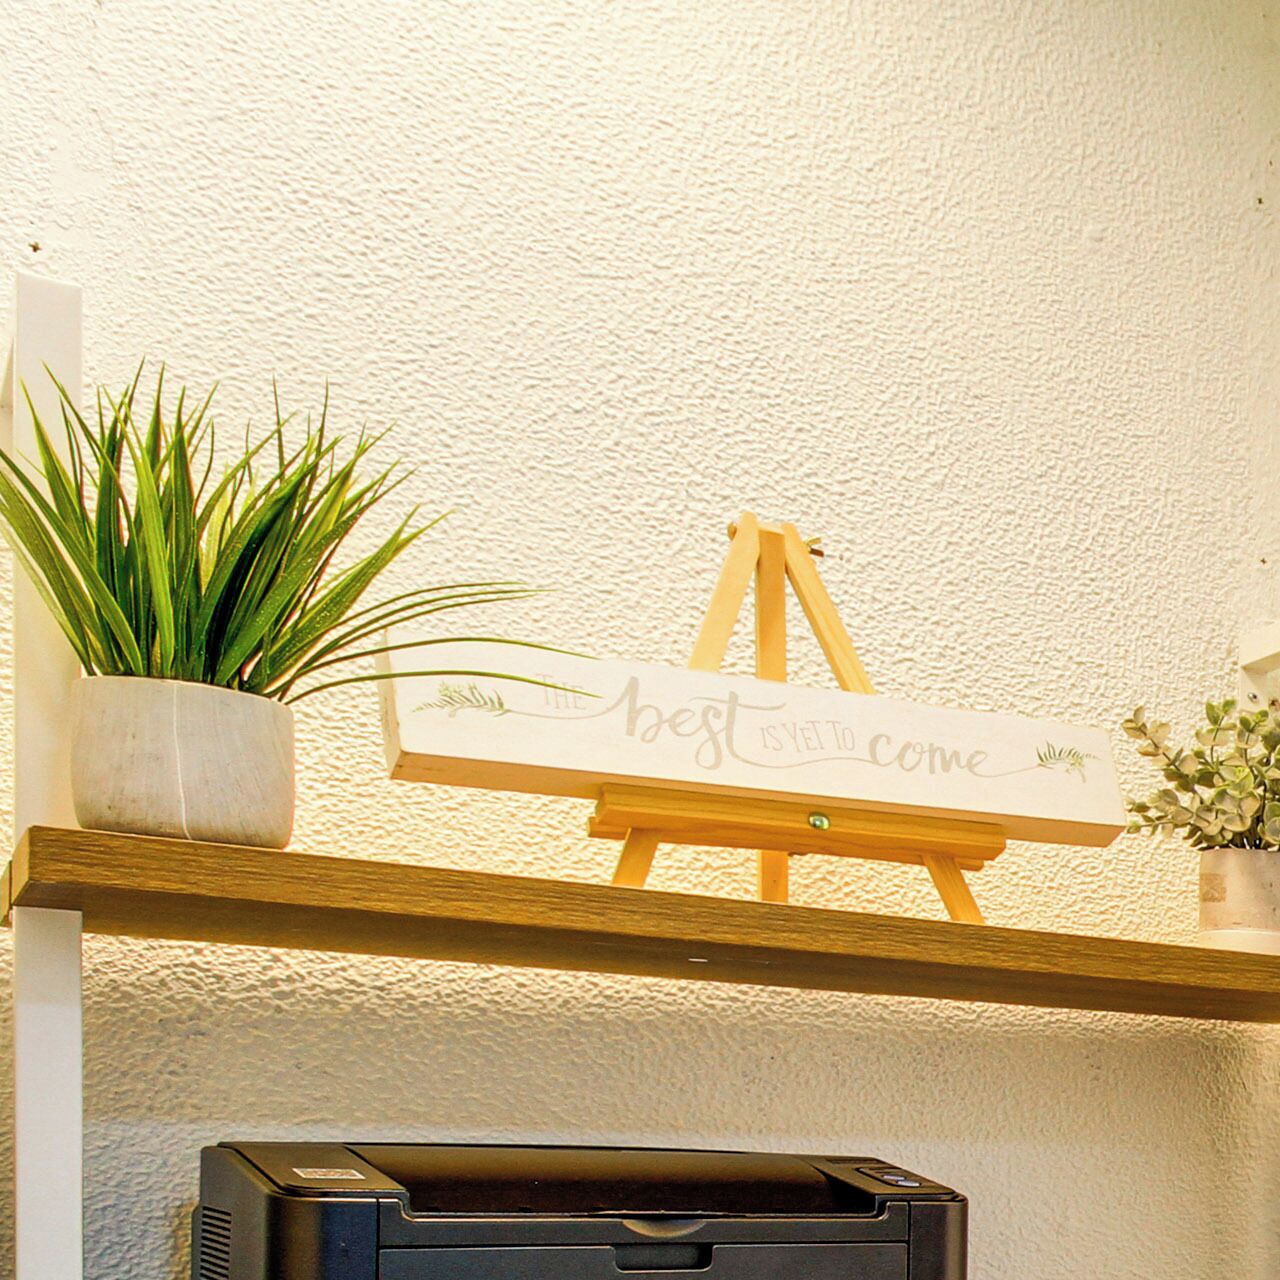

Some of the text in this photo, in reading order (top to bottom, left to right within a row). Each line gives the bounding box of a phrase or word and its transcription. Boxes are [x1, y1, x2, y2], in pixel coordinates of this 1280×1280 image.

[606, 675, 786, 770] best
[760, 726, 783, 752] IS
[827, 720, 855, 751] TO
[868, 733, 990, 777] come
